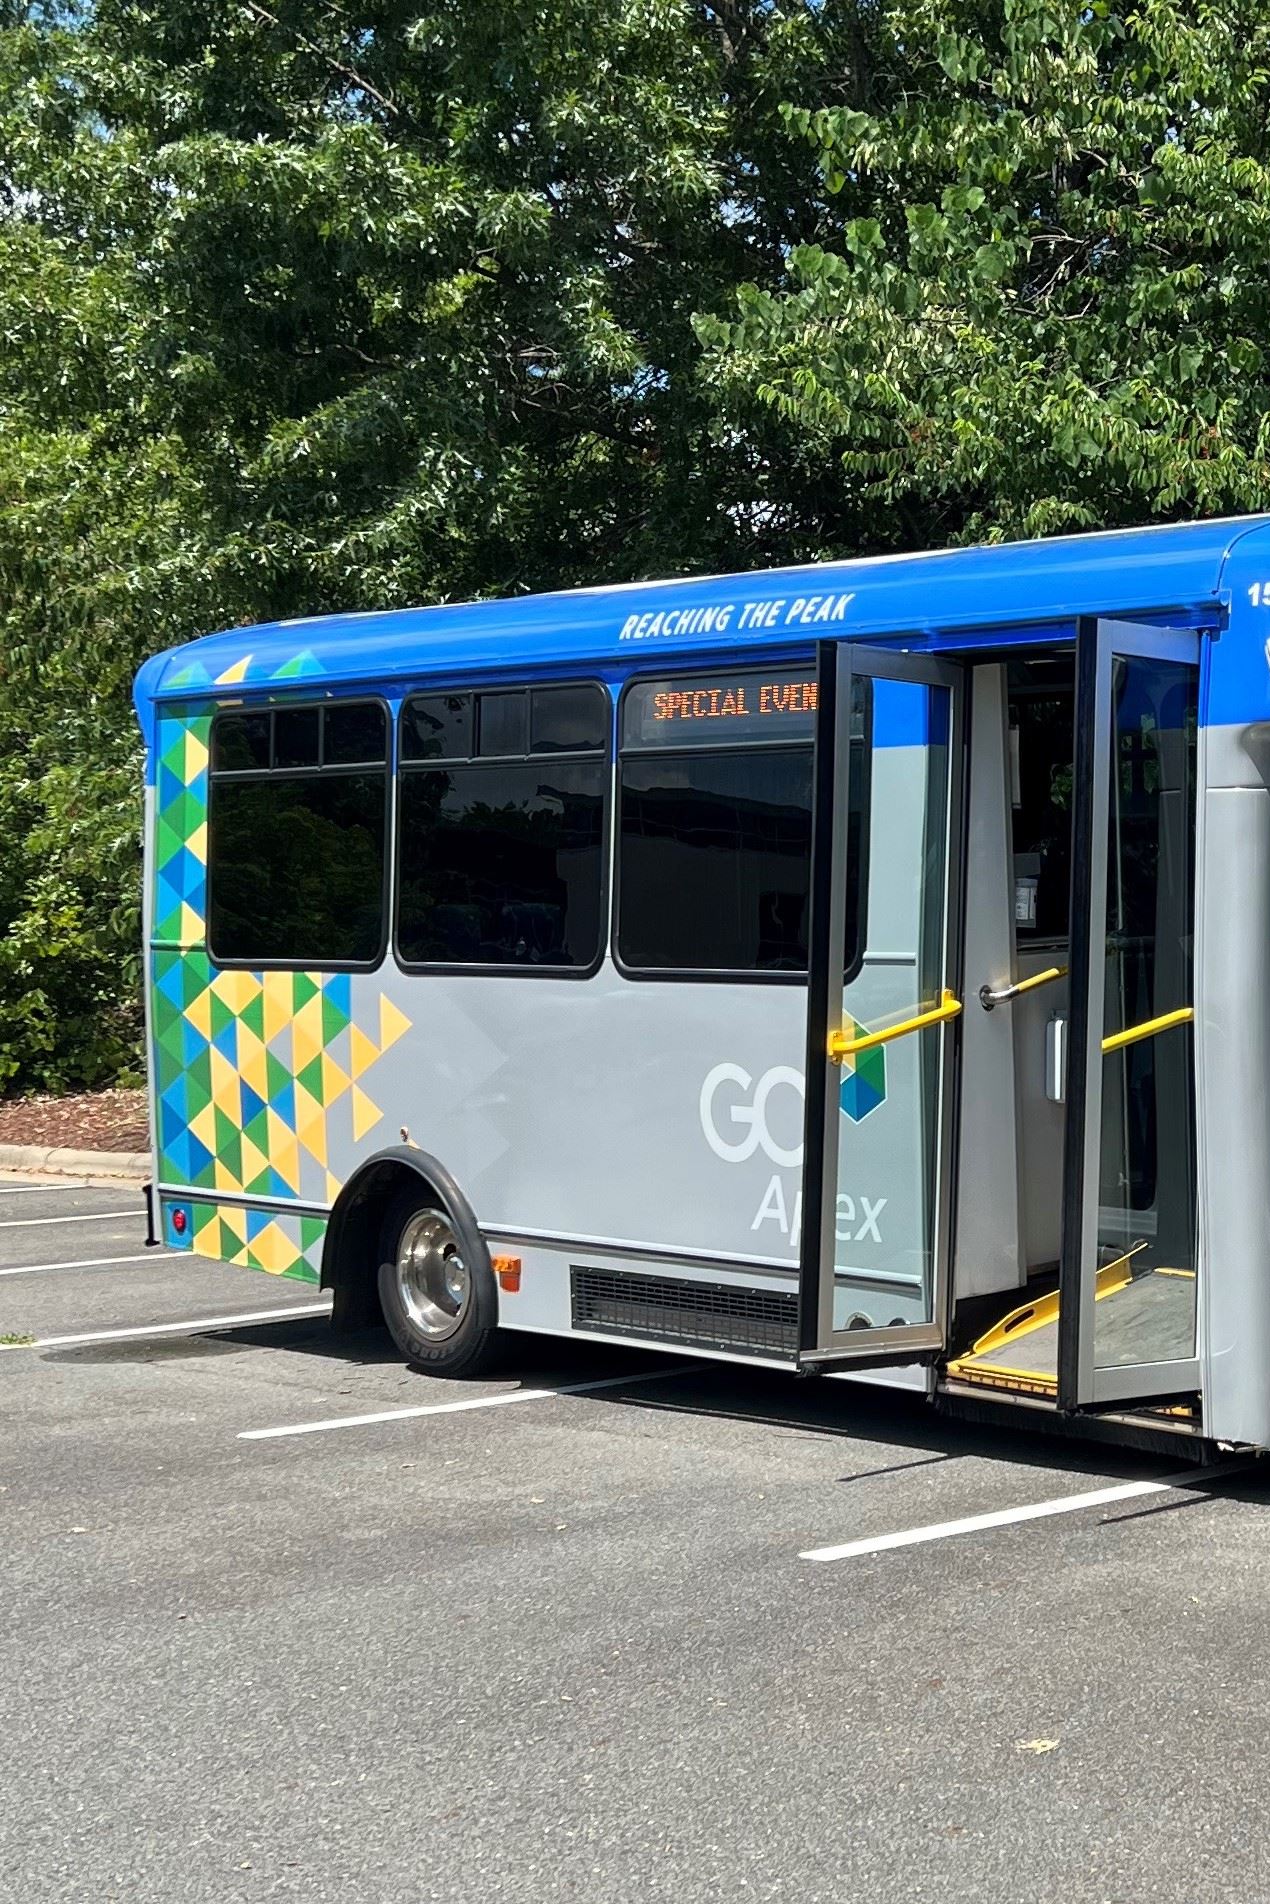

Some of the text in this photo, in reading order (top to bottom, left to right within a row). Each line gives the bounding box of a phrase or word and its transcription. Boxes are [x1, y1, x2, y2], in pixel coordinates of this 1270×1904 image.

[619, 592, 856, 641] REACHING THE PEAK
[653, 682, 819, 720] SPECIAL EVEN
[700, 1062, 805, 1168] GO
[751, 1174, 888, 1247] Aex
